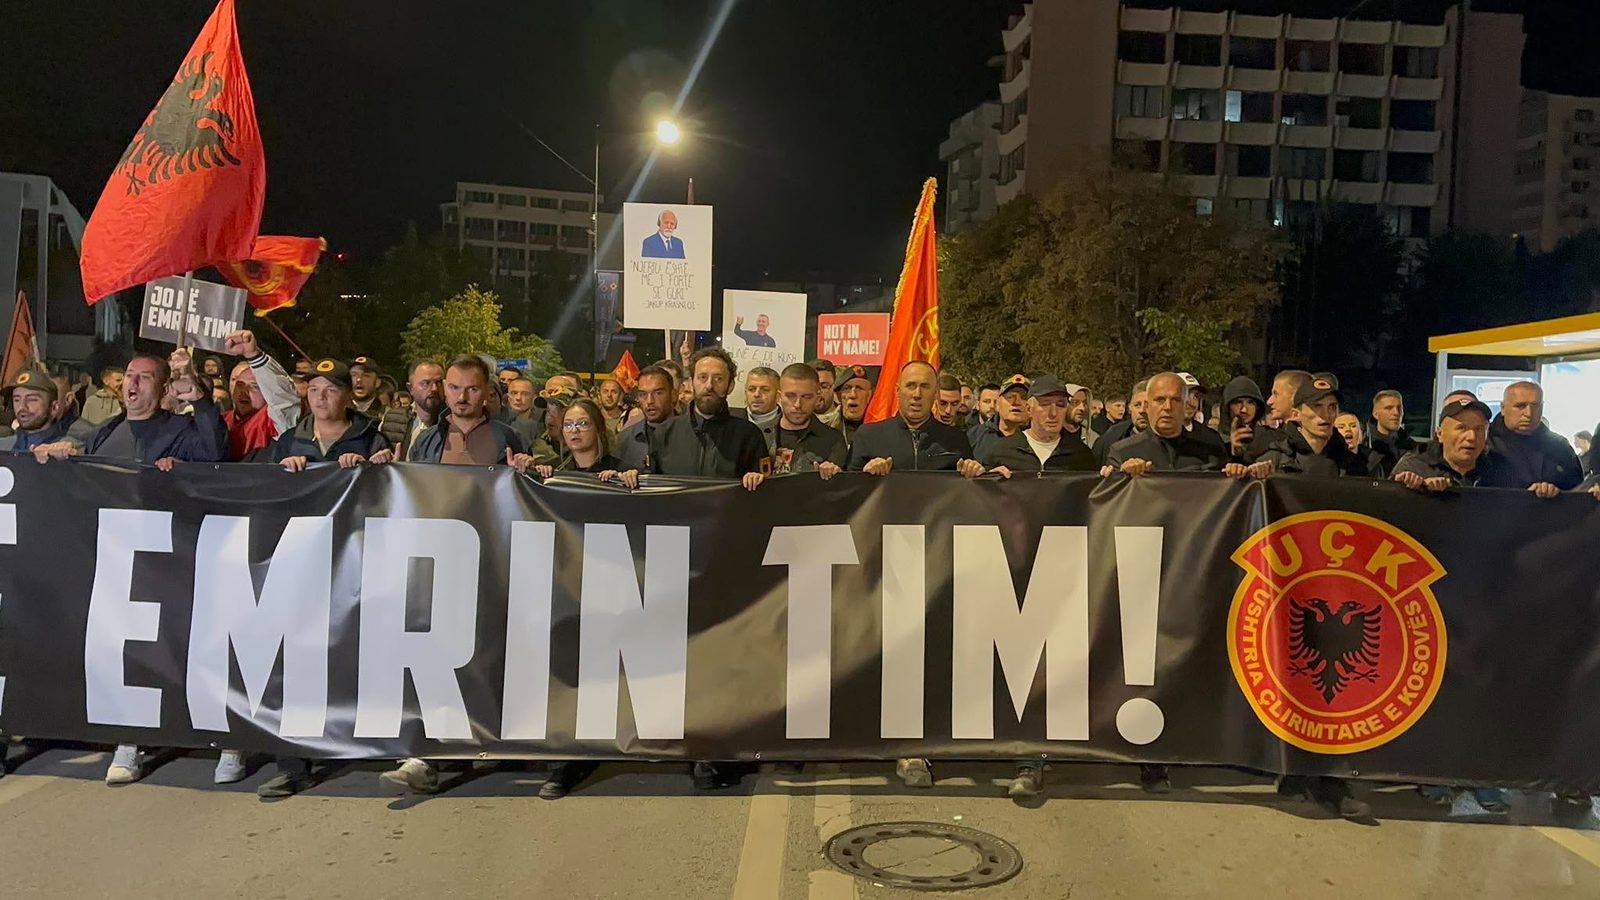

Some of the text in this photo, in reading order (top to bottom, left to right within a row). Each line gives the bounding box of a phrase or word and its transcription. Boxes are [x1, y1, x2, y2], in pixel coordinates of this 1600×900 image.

[150, 286, 174, 309] JO
[823, 339, 880, 355] MY NAME!
[824, 323, 860, 339] NOT IN
[1261, 522, 1416, 591] UÇK
[84, 508, 691, 740] EMRIN
[761, 524, 1165, 745] TIM!
[1242, 588, 1431, 740] USHTRIA ÇLIRIMTARE E KOSOVËS
